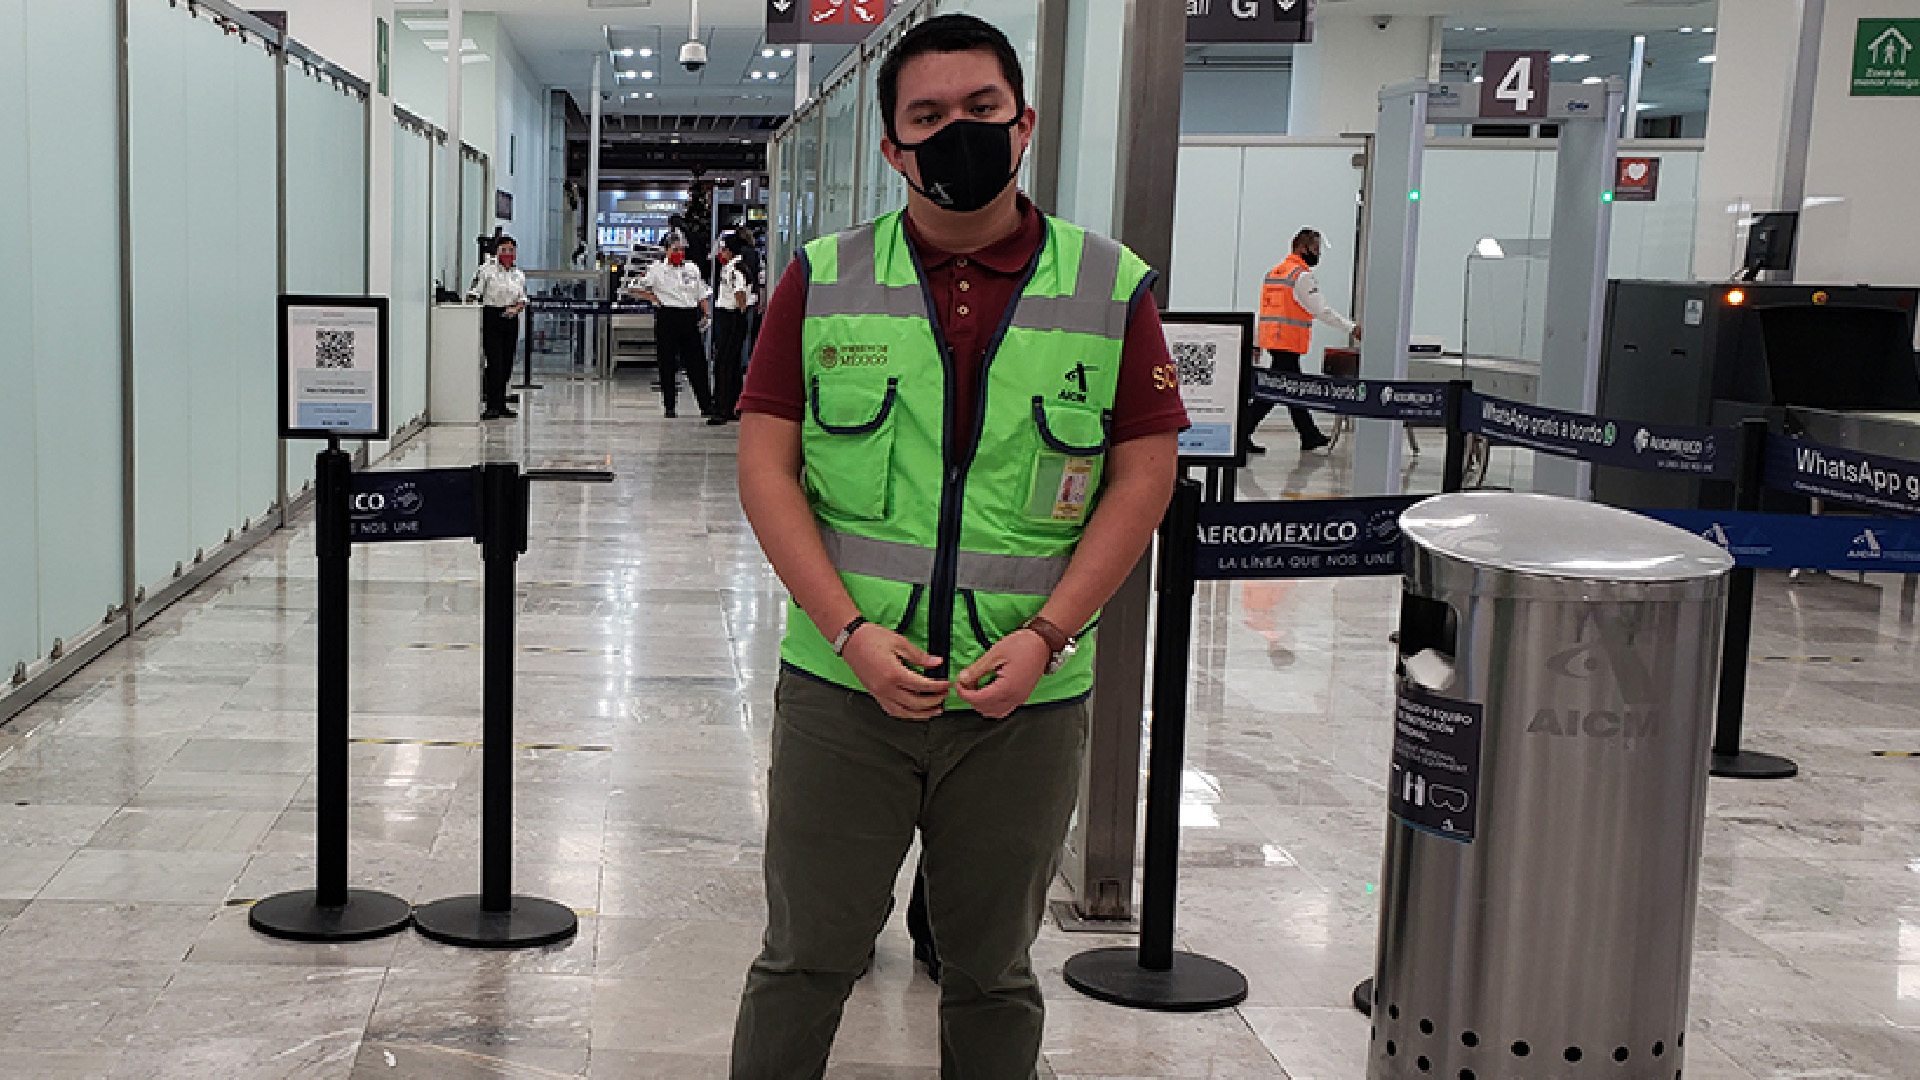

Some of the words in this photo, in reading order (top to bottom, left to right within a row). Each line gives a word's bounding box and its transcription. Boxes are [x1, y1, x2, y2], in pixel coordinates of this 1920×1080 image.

[1496, 57, 1534, 111] 4
[741, 178, 752, 200] 1
[1482, 401, 1530, 433] WhatsApp
[1532, 414, 1559, 437] gratis
[1797, 447, 1901, 496] WhatsApp
[1196, 520, 1358, 544] AEROMEXICO
[1217, 557, 1237, 569] LA
[1289, 555, 1320, 569] QUE
[1326, 553, 1357, 566] NOS
[1364, 551, 1395, 565] UNE
[1433, 708, 1473, 726] EQUIPO
[1527, 708, 1660, 738] AICM
